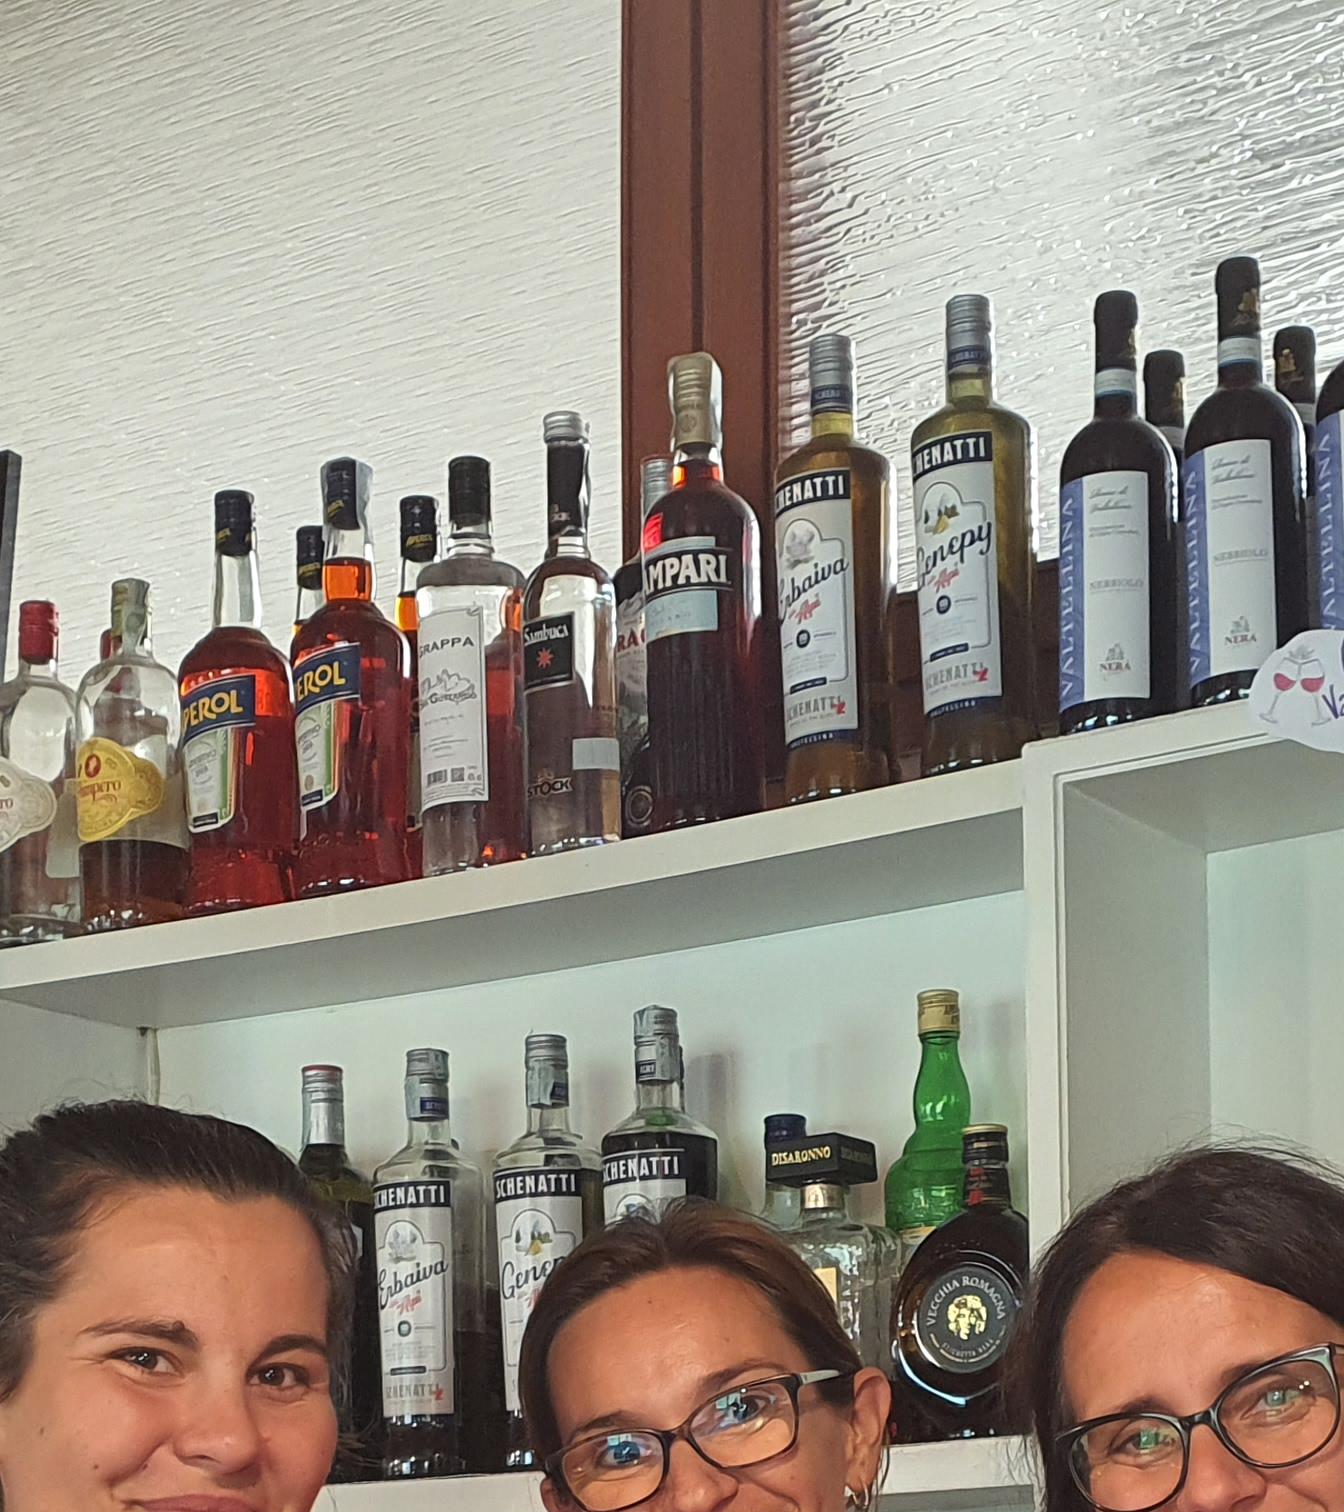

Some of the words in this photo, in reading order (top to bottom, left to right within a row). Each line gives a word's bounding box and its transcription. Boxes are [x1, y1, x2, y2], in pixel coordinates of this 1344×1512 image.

[913, 436, 986, 476] HENATTI
[777, 475, 844, 510] HENATTI
[644, 553, 728, 596] AMPARI
[1061, 498, 1074, 697] VALTELLINA
[296, 660, 346, 700] EROL
[183, 689, 244, 733] PEROL
[528, 777, 570, 797] STOCK
[771, 1145, 831, 1166] DISARONNO
[496, 1173, 577, 1199] SCHENATTI
[502, 1256, 566, 1300] Gene
[925, 1279, 960, 1327] VECCHIA
[961, 1275, 1006, 1320] ROMAGNA
